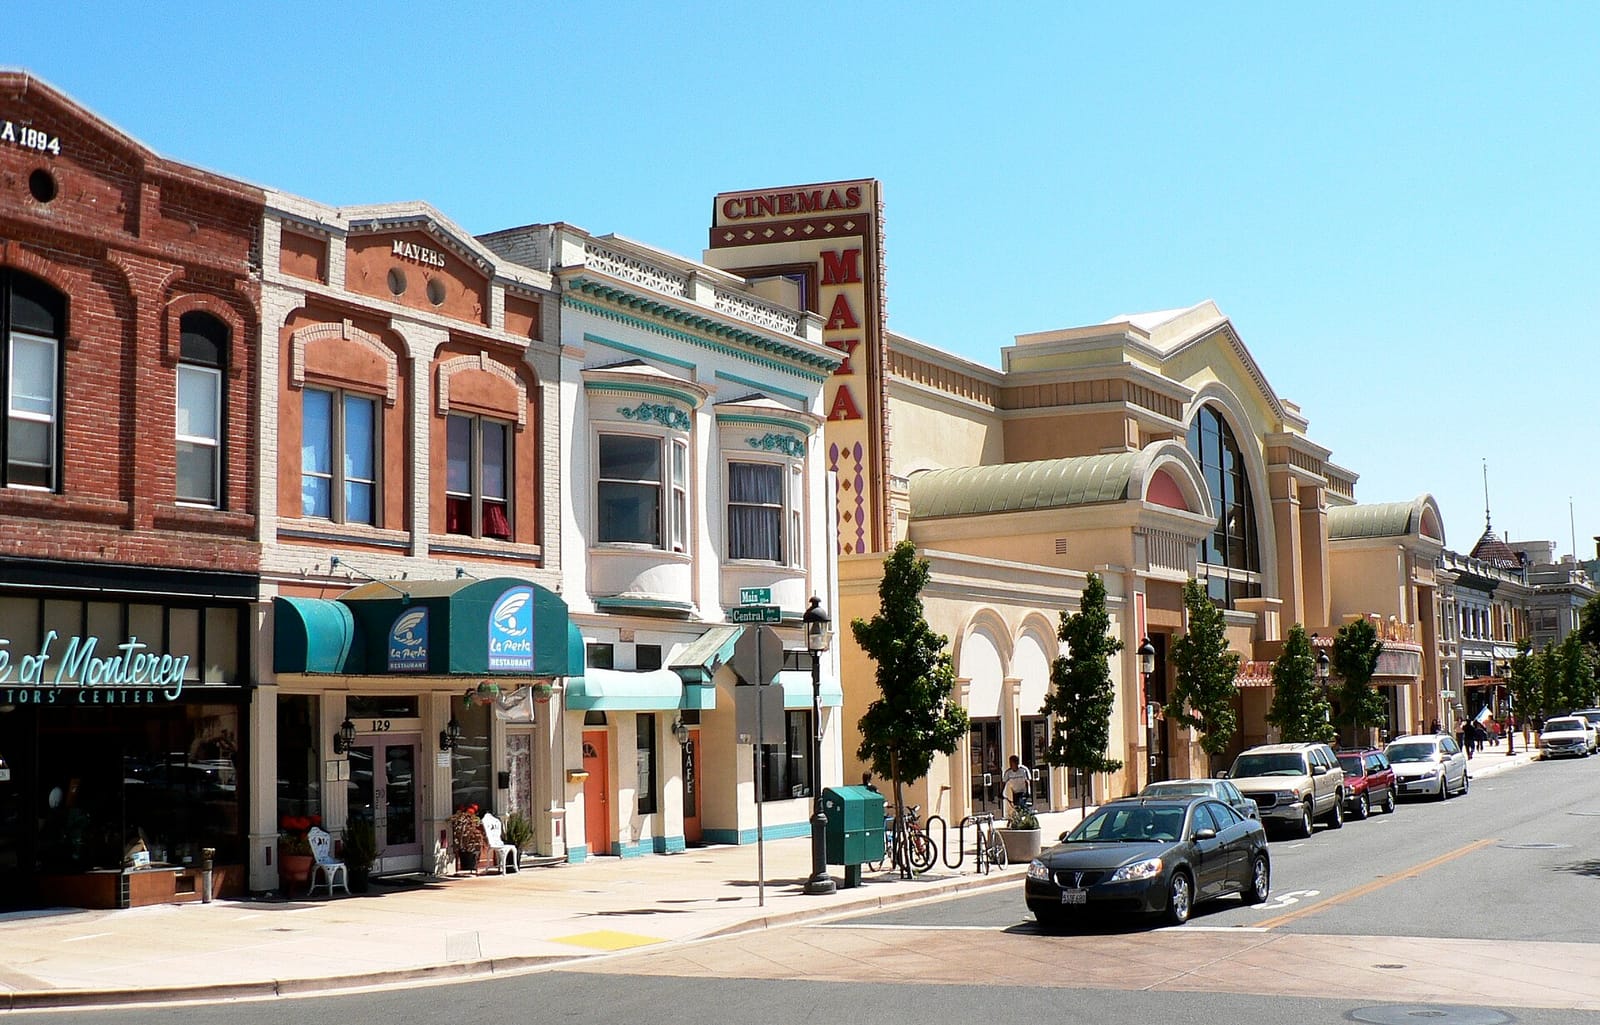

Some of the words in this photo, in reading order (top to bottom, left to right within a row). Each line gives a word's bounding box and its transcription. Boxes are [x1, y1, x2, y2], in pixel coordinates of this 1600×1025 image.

[1, 121, 15, 142] A
[20, 126, 61, 155] 1894
[722, 186, 861, 220] CINEMAS
[392, 239, 445, 267] MAYERS
[820, 248, 864, 422] MAYA
[741, 590, 759, 603] Main
[733, 609, 764, 622] Central
[490, 637, 502, 652] La
[503, 639, 531, 652] Perla
[390, 648, 401, 658] La
[402, 646, 427, 659] Perla
[20, 630, 58, 685] of
[55, 636, 189, 701] Monterey
[490, 658, 531, 667] RESTAURANT
[78, 690, 154, 703] CENTER
[372, 719, 390, 732] 129
